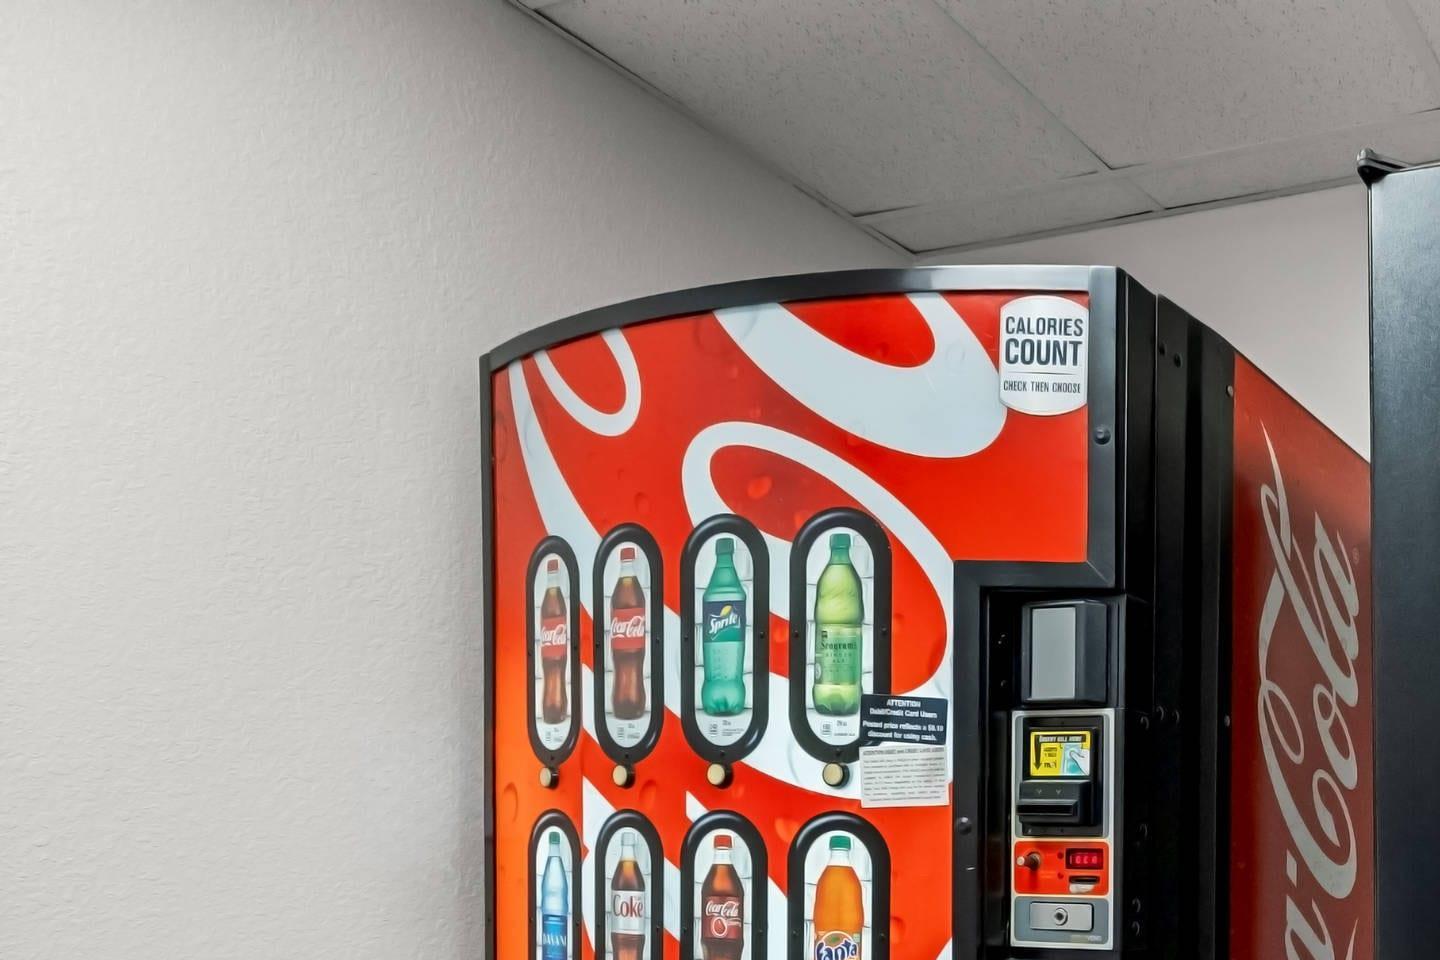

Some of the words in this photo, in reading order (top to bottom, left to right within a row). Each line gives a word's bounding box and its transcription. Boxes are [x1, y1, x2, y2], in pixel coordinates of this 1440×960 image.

[1005, 316, 1083, 337] CALORIES
[1005, 338, 1083, 367] COUNT
[1003, 380, 1027, 392] CHECK
[1031, 381, 1049, 393] THEN
[1052, 382, 1081, 394] CHOOSE
[709, 613, 740, 635] Sprite
[884, 722, 898, 730] price
[893, 731, 902, 739] for
[613, 894, 643, 918] Coke
